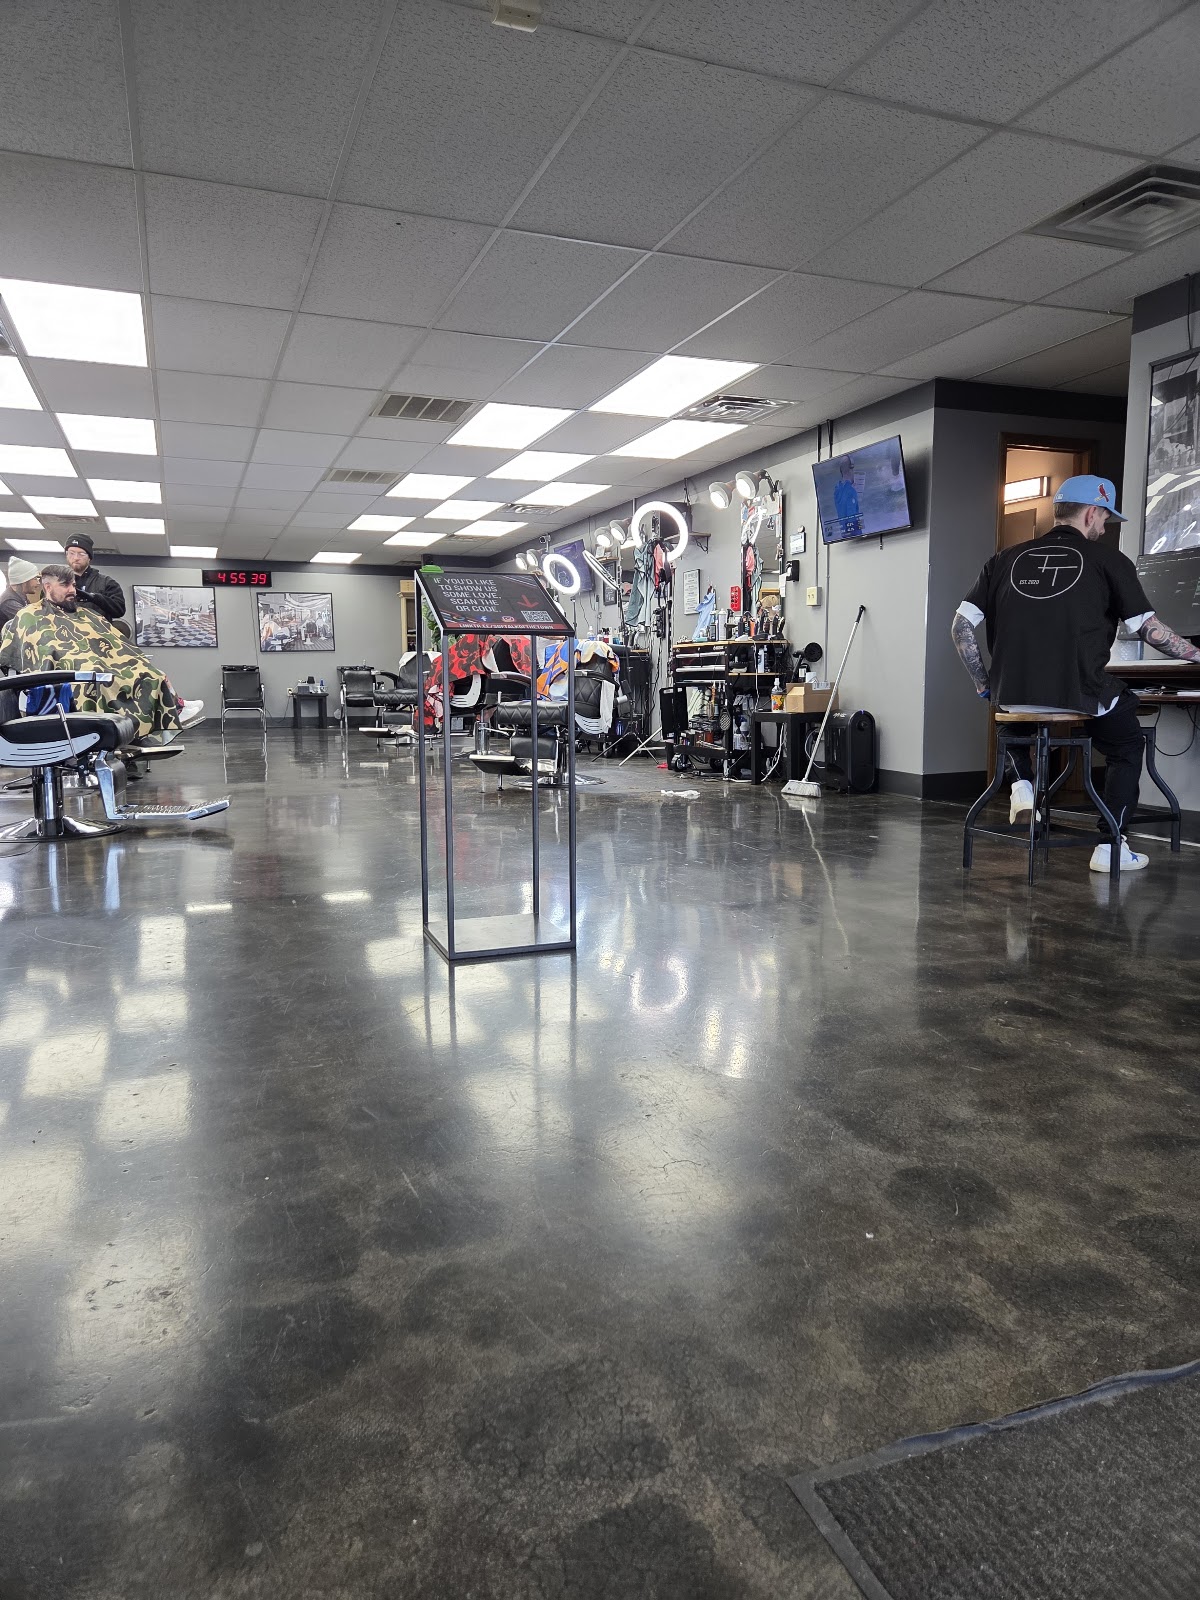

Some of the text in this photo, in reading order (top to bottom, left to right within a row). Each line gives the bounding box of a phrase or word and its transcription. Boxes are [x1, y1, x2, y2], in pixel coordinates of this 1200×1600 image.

[217, 572, 267, 584] 4 55 39
[453, 584, 482, 592] SHOW
[471, 605, 501, 613] CODE.
